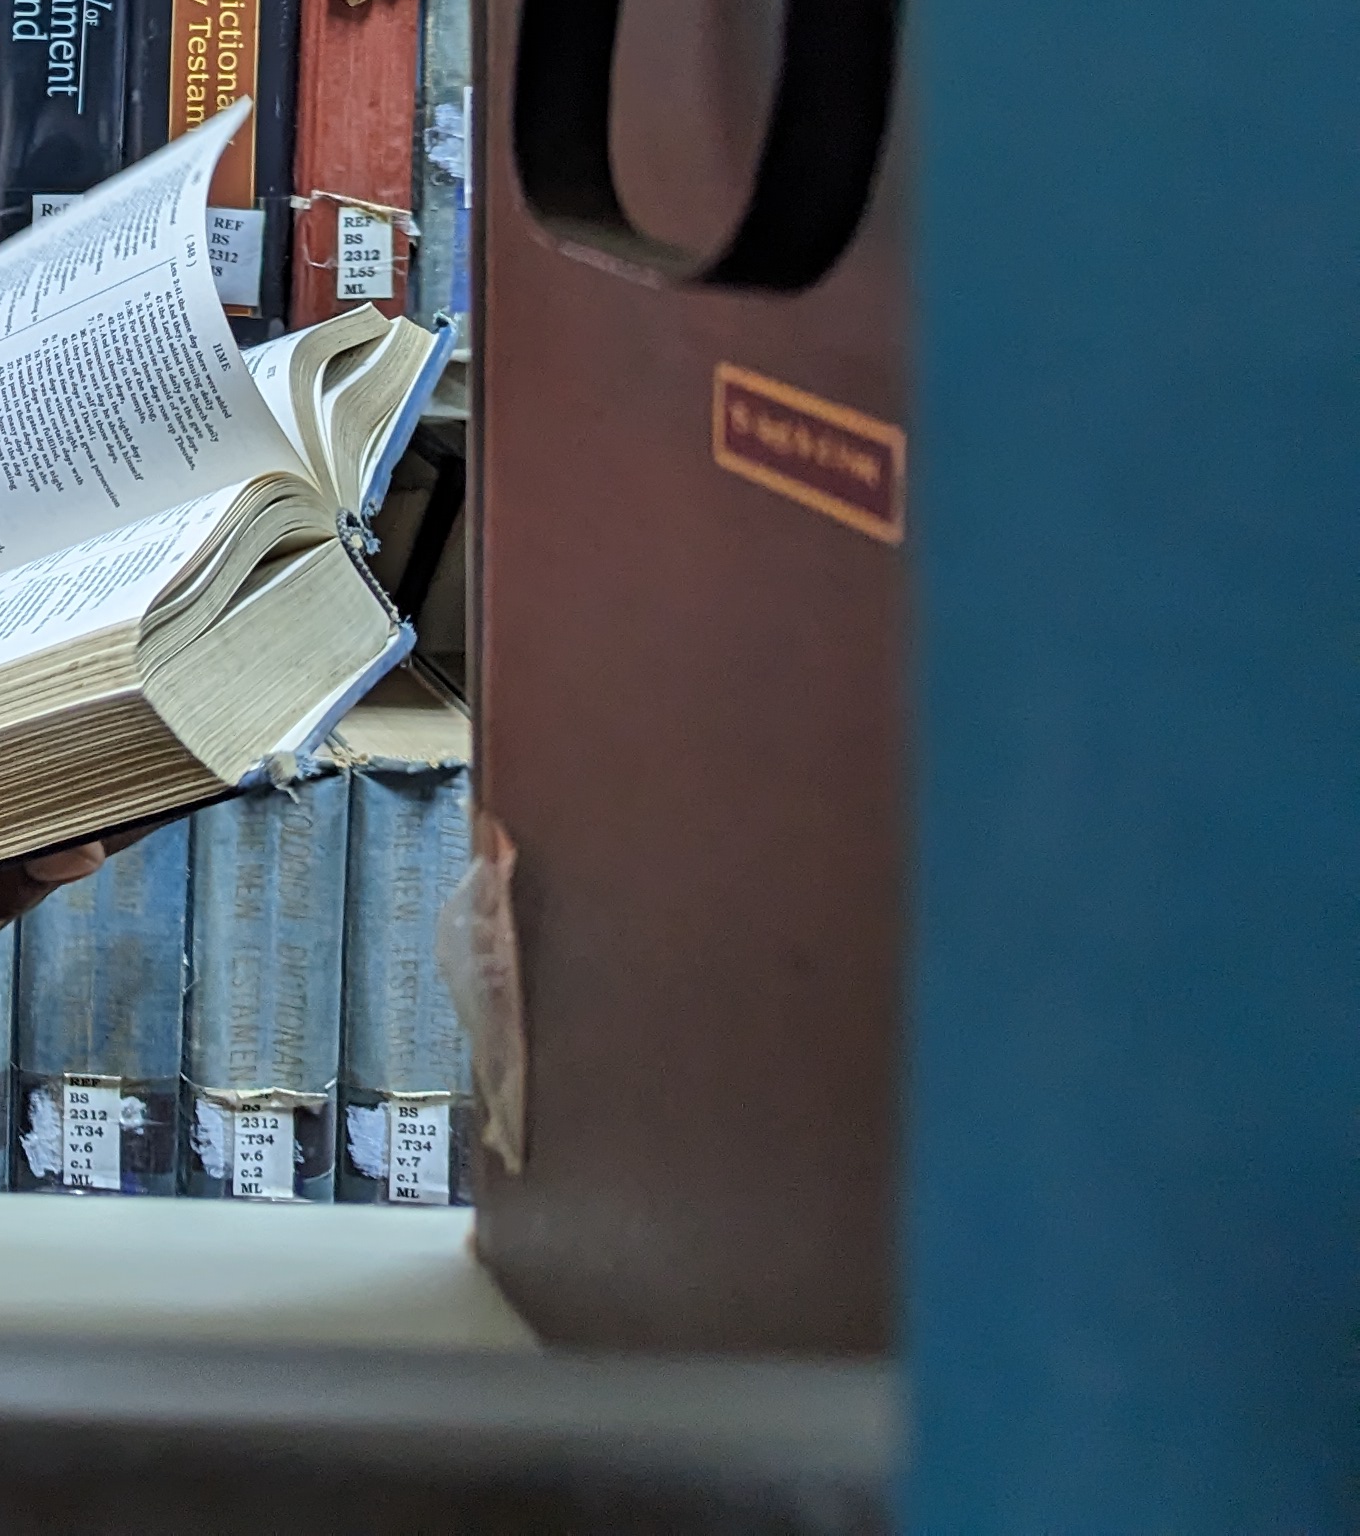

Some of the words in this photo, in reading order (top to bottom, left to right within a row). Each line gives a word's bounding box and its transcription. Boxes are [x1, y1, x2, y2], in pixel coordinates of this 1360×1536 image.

[86, 9, 99, 26] OF
[186, 16, 212, 132] Testam
[214, 216, 244, 232] REF
[343, 216, 373, 228] REF
[211, 232, 230, 245] BS
[344, 233, 363, 245] BS
[208, 250, 238, 264] 2312
[344, 249, 380, 262] 2312
[344, 284, 366, 295] ML
[182, 312, 192, 334] same
[188, 334, 198, 349] day
[196, 350, 208, 372] there
[206, 374, 218, 394] were
[215, 395, 232, 419] added
[399, 1107, 419, 1118] BS
[398, 1124, 437, 1136] 2312
[397, 1140, 433, 1152] .T34
[397, 1156, 421, 1168] v.7
[397, 1173, 420, 1184] c.1
[396, 1188, 420, 1199] ML
